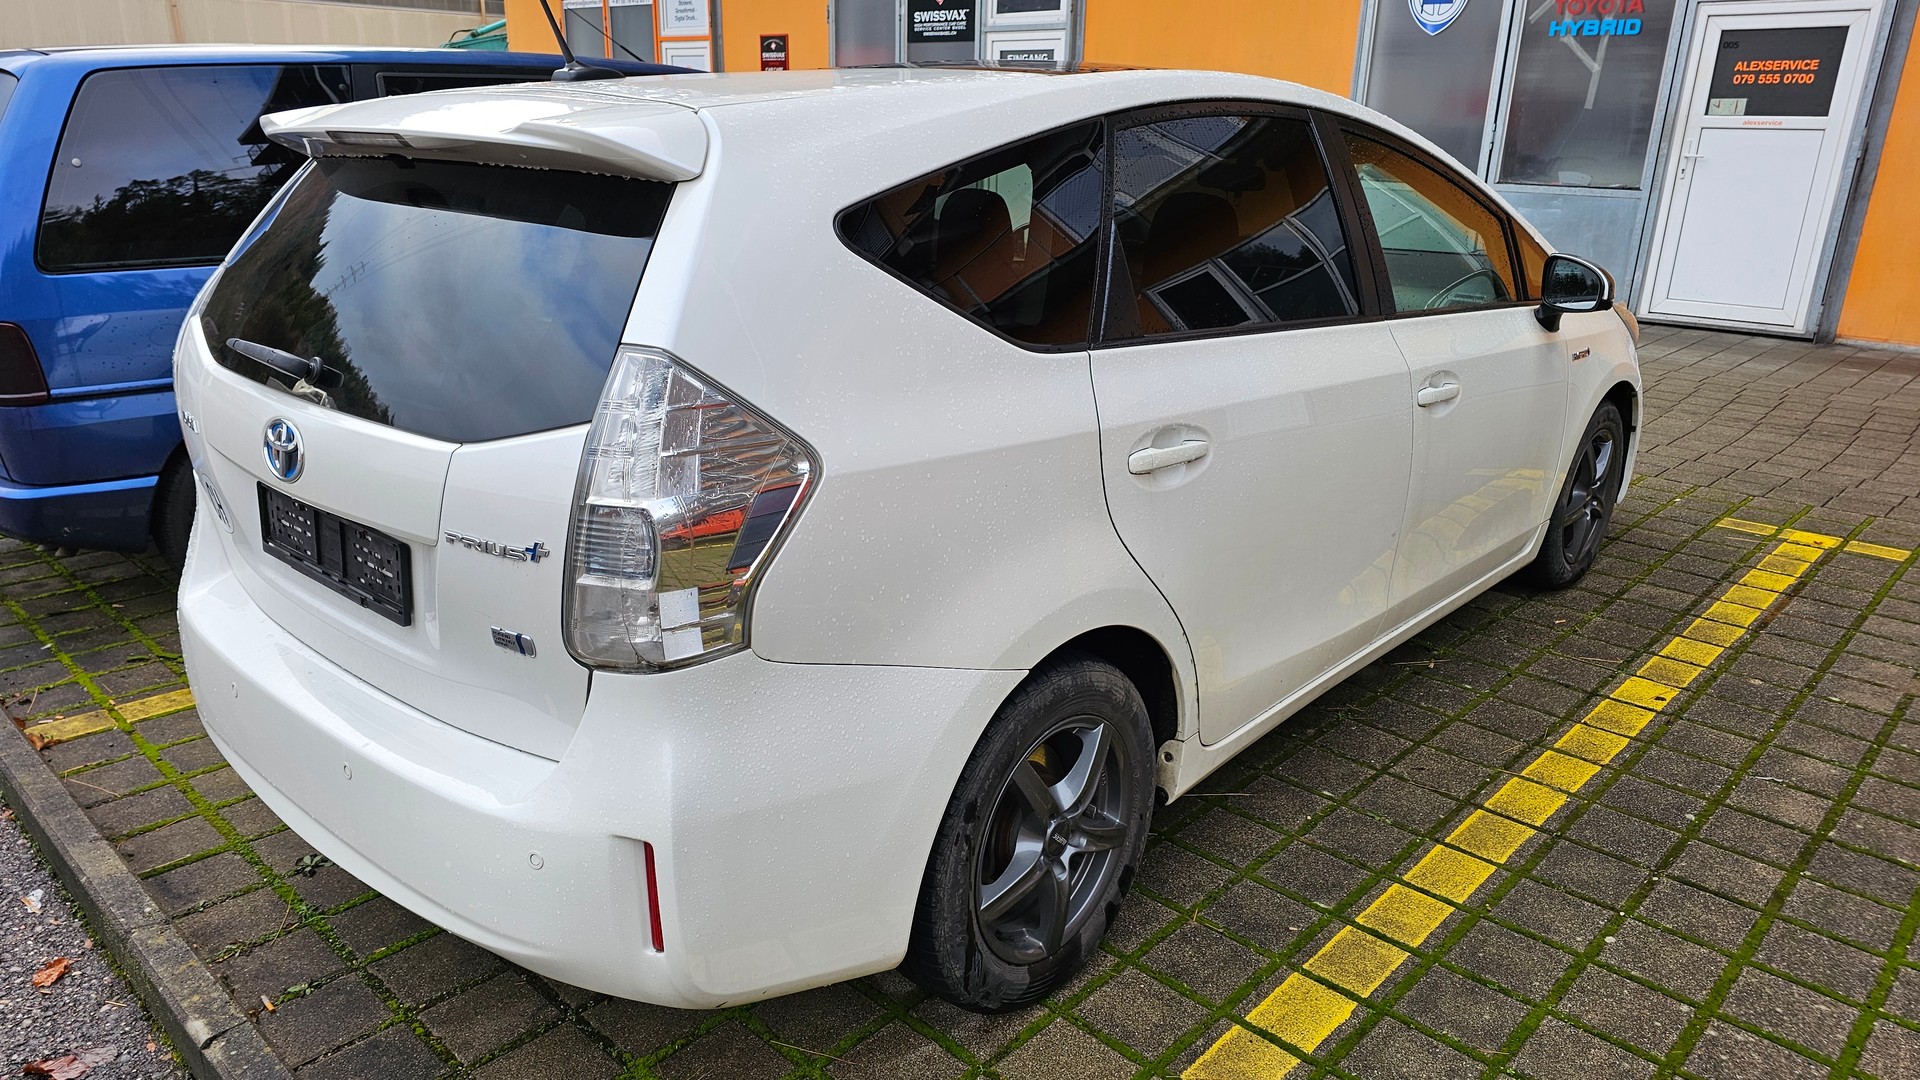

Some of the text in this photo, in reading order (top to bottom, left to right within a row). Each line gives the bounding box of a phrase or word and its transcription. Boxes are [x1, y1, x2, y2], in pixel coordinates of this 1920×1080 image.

[1555, 0, 1644, 15] TOYOTA
[914, 9, 969, 22] SWISSVAX
[1549, 18, 1642, 37] HYBRID
[1722, 41, 1741, 49] 005
[1734, 59, 1820, 71] ALEXSERVICE
[1733, 73, 1815, 85] 079 555 0700
[1742, 119, 1784, 127] alexservice
